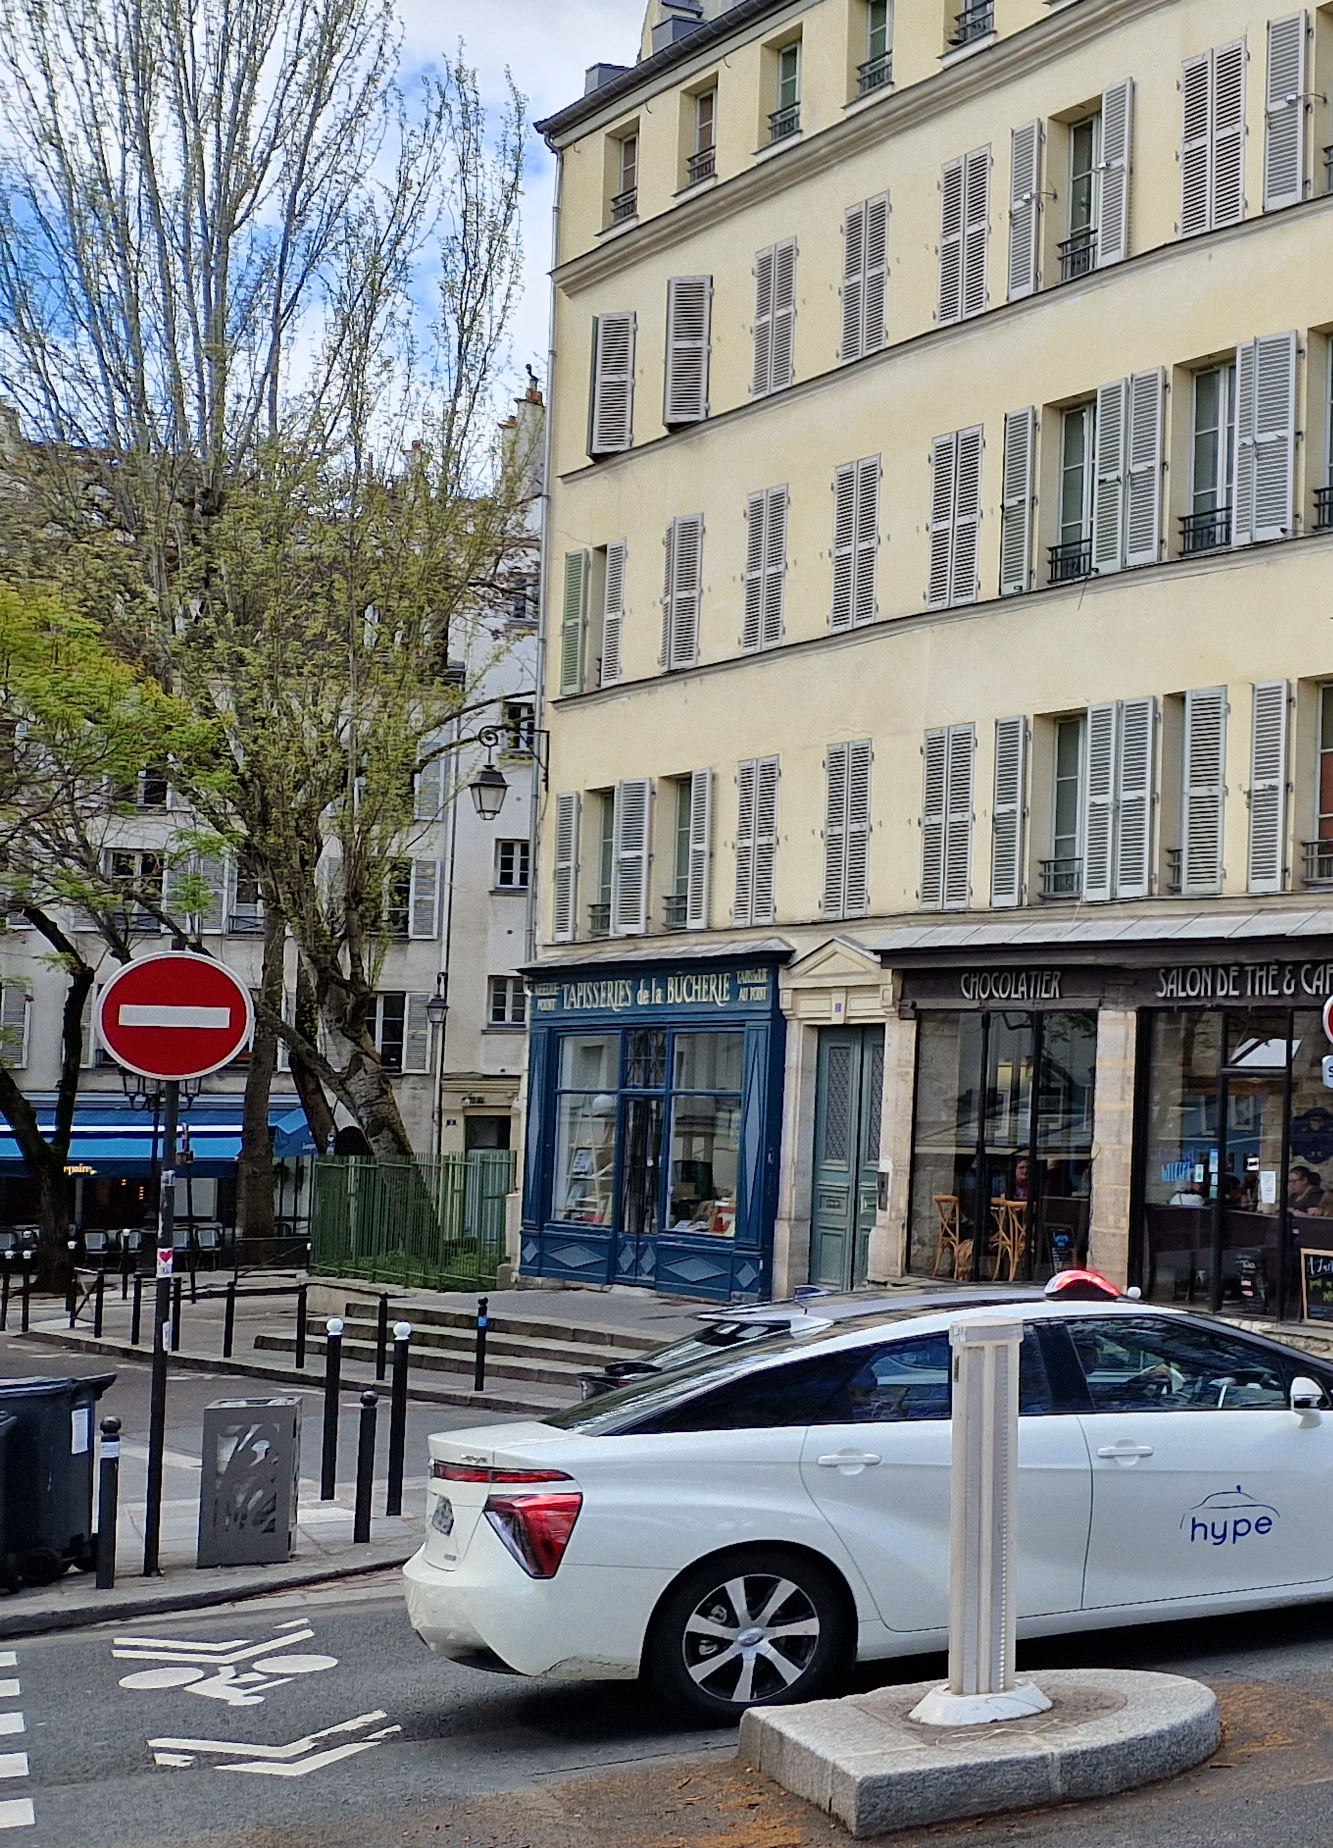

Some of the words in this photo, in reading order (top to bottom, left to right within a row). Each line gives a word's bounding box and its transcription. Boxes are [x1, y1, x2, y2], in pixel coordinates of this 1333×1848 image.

[561, 980, 633, 1012] TAPISSERIES
[636, 978, 650, 1006] de
[651, 977, 663, 1004] la
[666, 971, 731, 1007] BÛCHERIE
[960, 971, 1061, 1000] CHOCOLATIER
[1156, 967, 1213, 998] SALON
[1216, 965, 1240, 997] DE
[1283, 965, 1296, 996] &
[1190, 1515, 1274, 1546] hype
